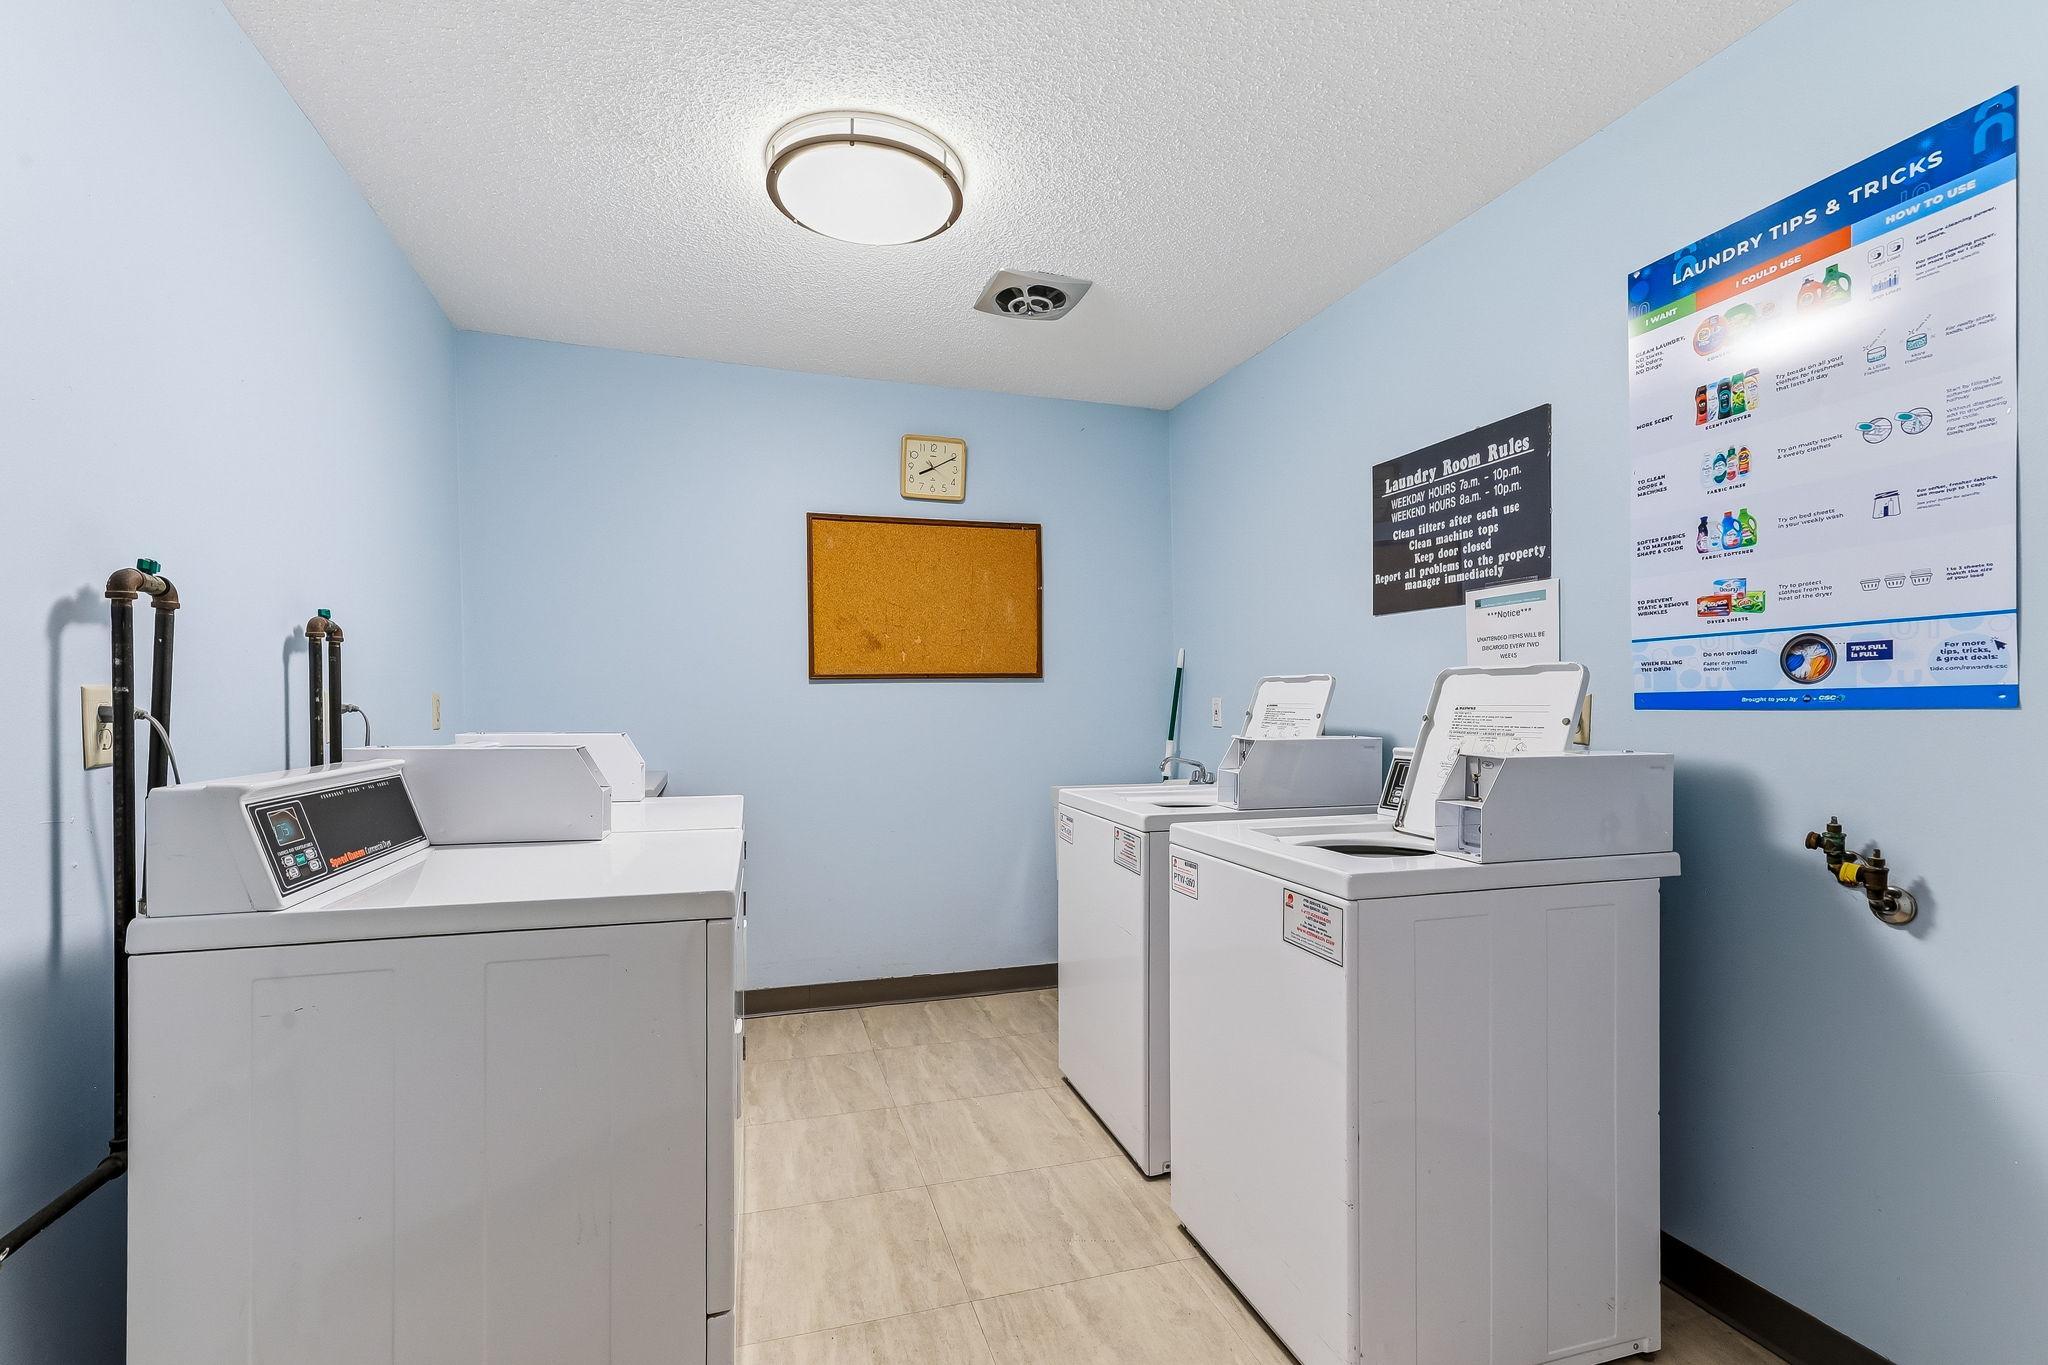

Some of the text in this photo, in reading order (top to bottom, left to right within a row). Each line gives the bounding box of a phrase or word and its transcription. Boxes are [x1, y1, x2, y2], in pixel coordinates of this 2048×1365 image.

[1885, 180, 1976, 225] HOW TO USE
[1672, 150, 1942, 285] LAUNDRY TIPS & TRICKS
[1736, 255, 1801, 288] I COULD USE
[1650, 307, 1677, 324] WANT
[1776, 373, 1785, 381] Try
[1818, 359, 1826, 367] all
[1828, 355, 1843, 365] your
[1776, 376, 1799, 386] clothes
[1811, 361, 1844, 375] freshness
[1791, 380, 1805, 389] lasts
[1807, 377, 1815, 385] all
[1816, 373, 1828, 383] day
[1637, 415, 1674, 430] MORE SCENT
[920, 444, 925, 452] 11
[931, 444, 937, 452] 12
[1798, 439, 1818, 450] musty
[1820, 434, 1843, 444] towels
[1806, 443, 1831, 454] clothes
[910, 451, 918, 459] 10
[908, 462, 958, 474] 9 3
[1385, 436, 1530, 493] Laundry Room Rules
[909, 475, 914, 483] 8
[1646, 474, 1665, 484] CLEAN
[919, 482, 924, 490] 7
[942, 484, 947, 492] 5
[1391, 465, 1521, 509] WEEKDAY HOURS 7a.m. 10p.m.
[1637, 487, 1668, 497] MACHINES
[1638, 483, 1657, 491] ODORS
[1391, 481, 1521, 523] WEEKEND HOURS 8a.m. 10p.m.
[1393, 502, 1520, 541] Clean filters after each use
[1785, 521, 1799, 529] your
[1801, 517, 1824, 527] weekly
[1826, 513, 1844, 521] wash
[1799, 512, 1810, 520] bed
[1812, 509, 1835, 518] sheets
[1409, 524, 1499, 550] Clean machine tops
[1637, 532, 1686, 546] SOFTER FABRICS
[1415, 539, 1491, 564] Keep door closed
[1637, 550, 1656, 558] SHAPE
[1663, 545, 1684, 554] COLOR
[1652, 540, 1681, 549] MAINTAIN
[1375, 545, 1546, 584] Report all problems to the property
[1405, 565, 1504, 591] manager immediately
[1798, 580, 1822, 589] protect
[1815, 592, 1833, 600] dryer
[1638, 609, 1668, 617] WRINKLES
[1477, 635, 1507, 643] UNATTENDED
[1940, 646, 1991, 655] tips, tricks,
[1944, 655, 1967, 663] great
[330, 855, 350, 868] Speed
[348, 849, 365, 861] Queen
